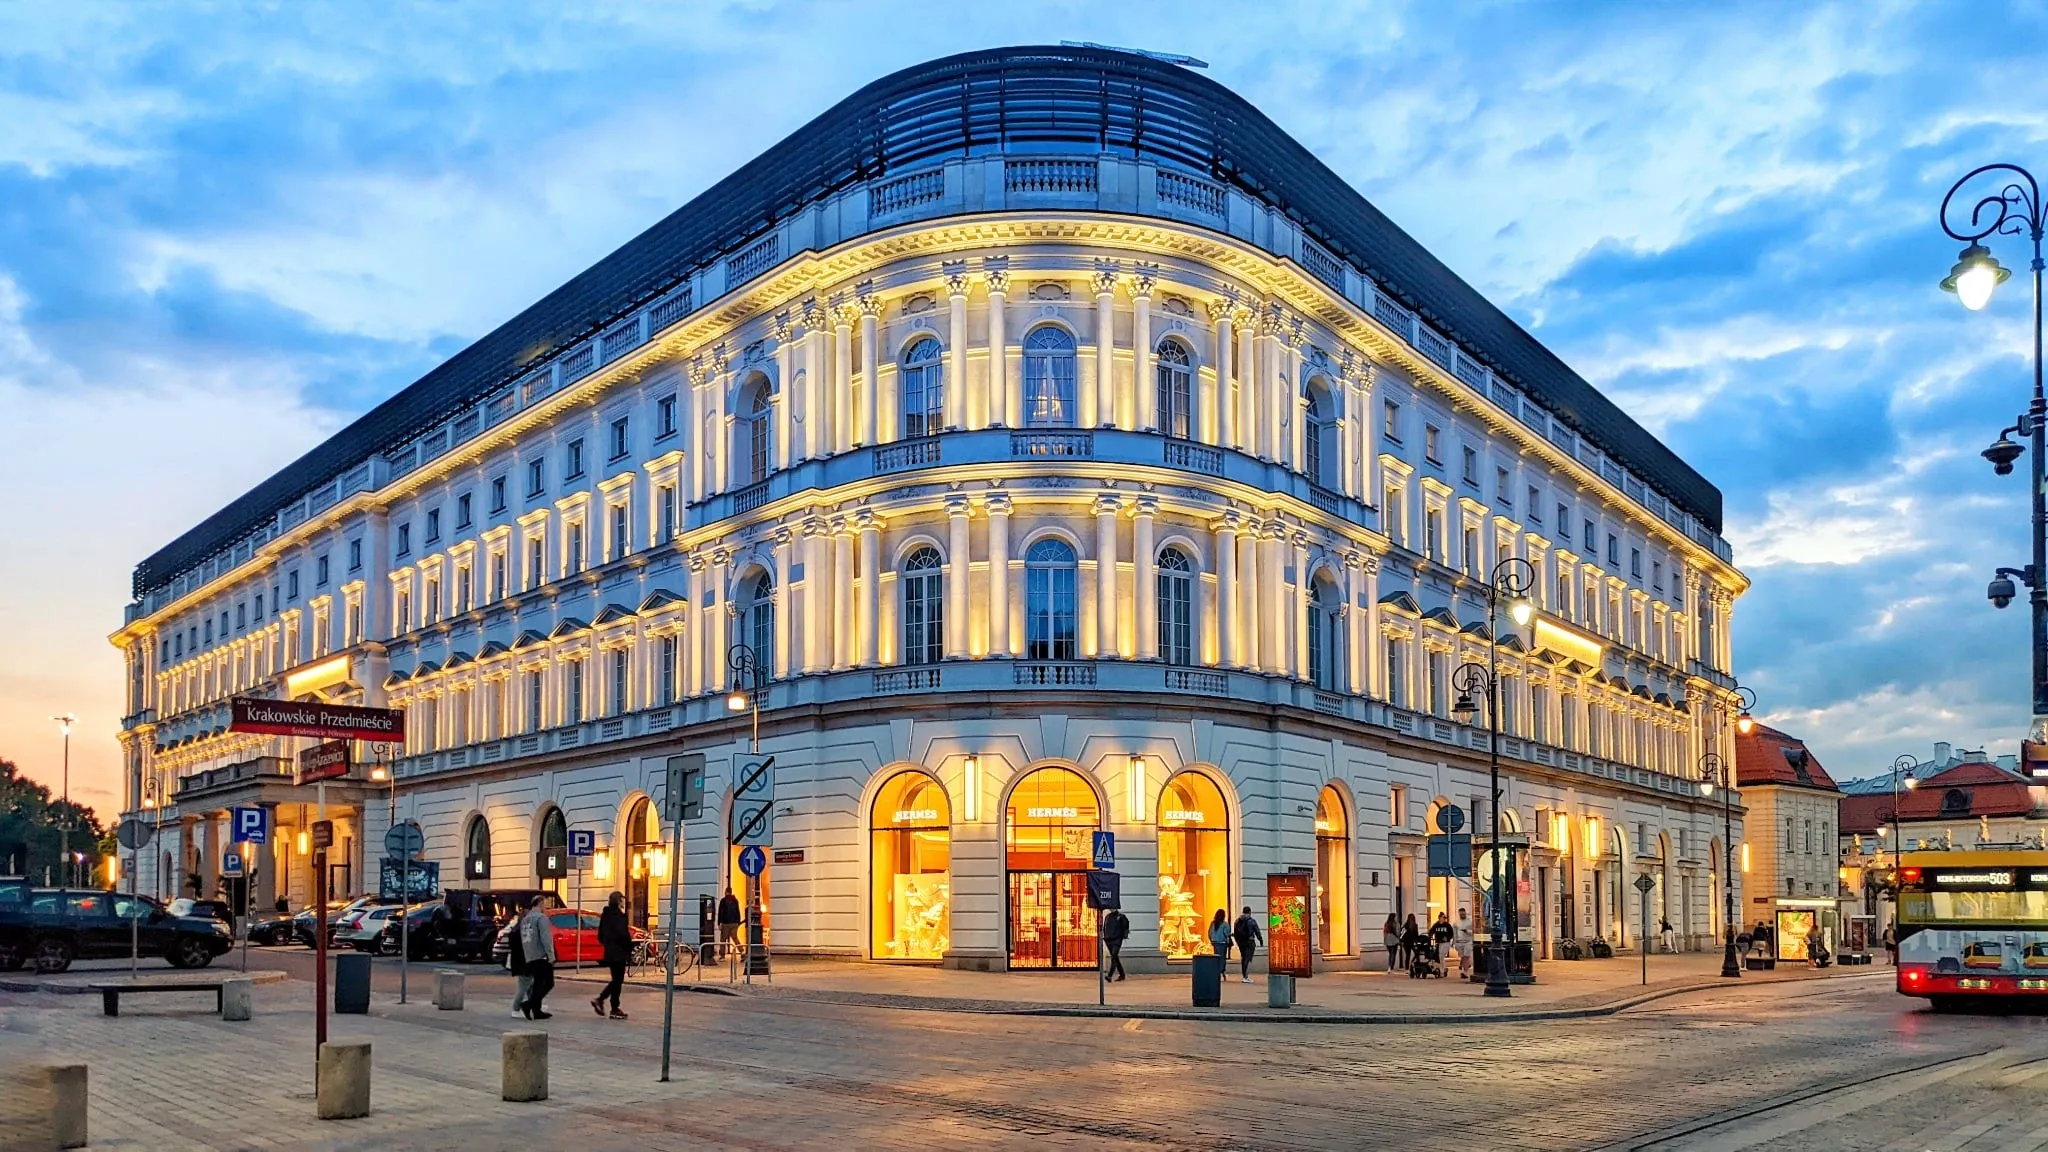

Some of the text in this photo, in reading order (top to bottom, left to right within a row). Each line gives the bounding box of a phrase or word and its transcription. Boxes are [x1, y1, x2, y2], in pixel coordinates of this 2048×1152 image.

[247, 706, 393, 730] Krakowskie Przedmieście
[241, 810, 260, 833] P
[1027, 807, 1078, 818] HERMÈS
[574, 832, 590, 853] P
[227, 854, 239, 869] P
[1989, 872, 2010, 885] 503
